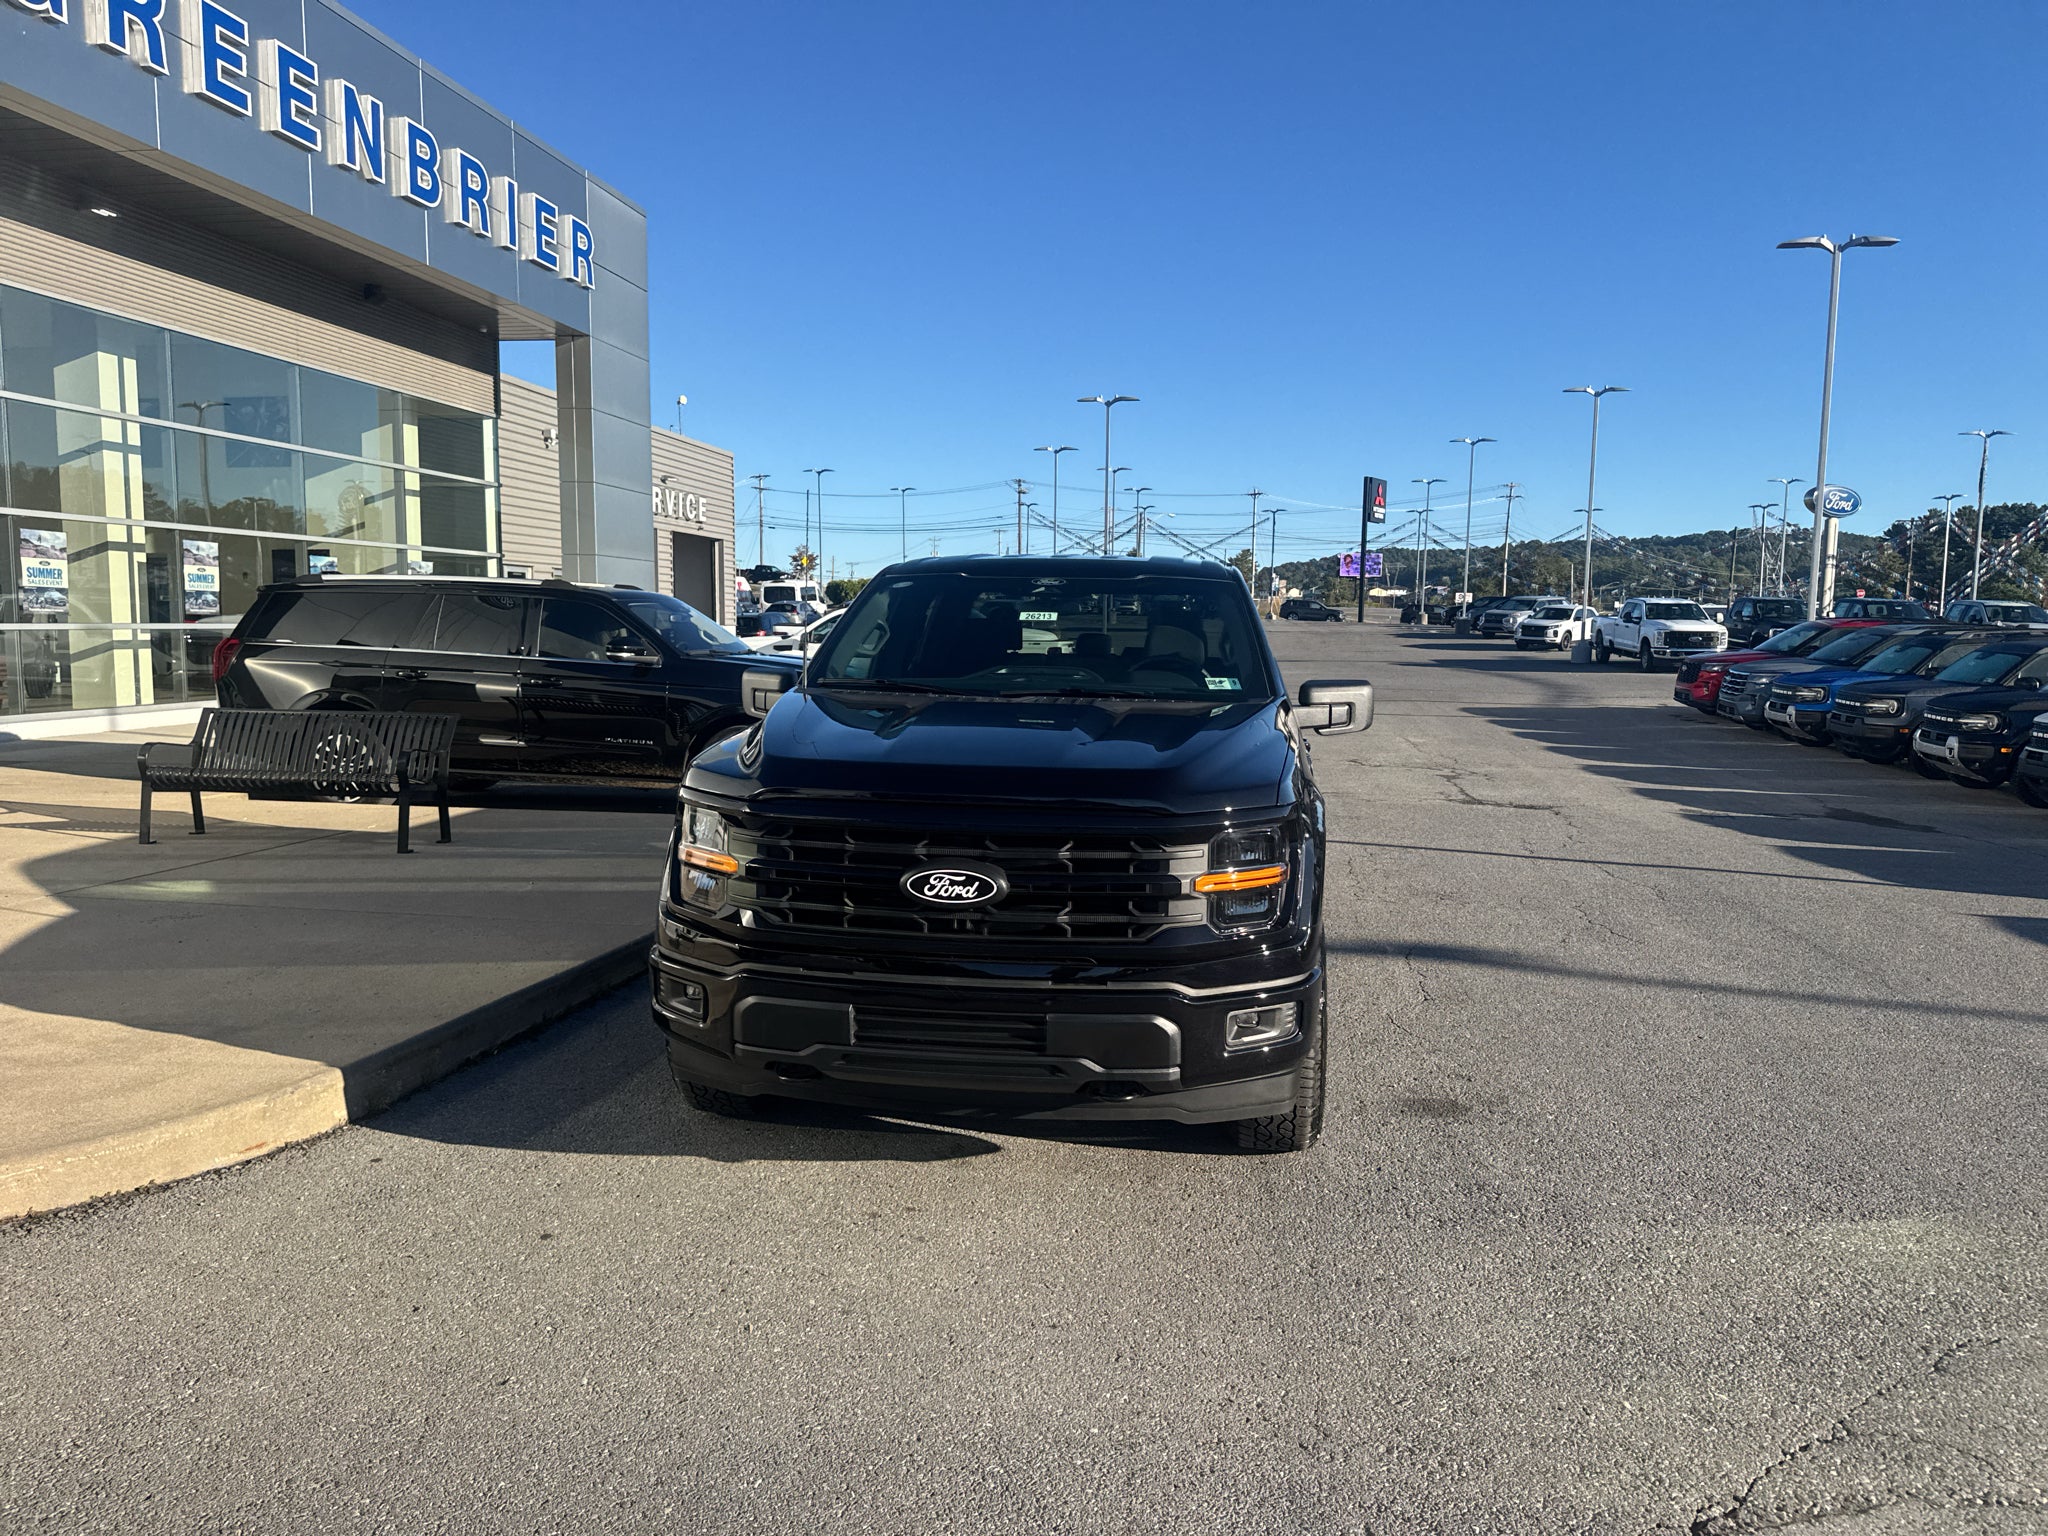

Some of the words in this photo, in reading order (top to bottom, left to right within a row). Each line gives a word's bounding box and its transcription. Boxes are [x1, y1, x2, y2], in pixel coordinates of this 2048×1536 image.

[6, 0, 595, 290] REENBRIER
[1825, 491, 1854, 512] Ford
[26, 566, 63, 580] SUMMER
[187, 573, 215, 583] SUMMER
[604, 737, 654, 745] PLATINUM
[923, 873, 980, 898] Ford
